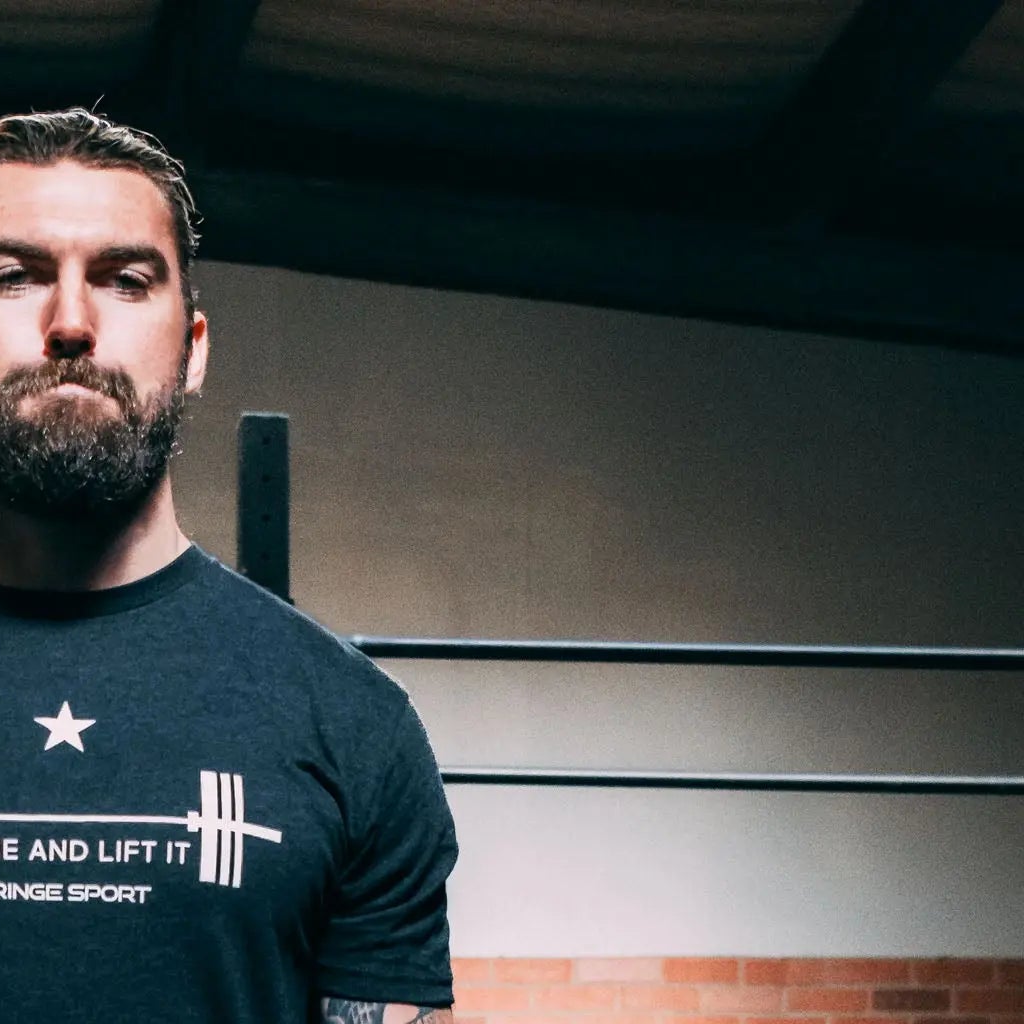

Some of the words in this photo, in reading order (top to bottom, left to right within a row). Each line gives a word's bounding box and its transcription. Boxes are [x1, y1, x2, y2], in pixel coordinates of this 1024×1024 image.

[28, 838, 89, 862] AND
[98, 840, 158, 864] LIFT
[166, 841, 192, 865] IT
[67, 884, 153, 904] SPORT
